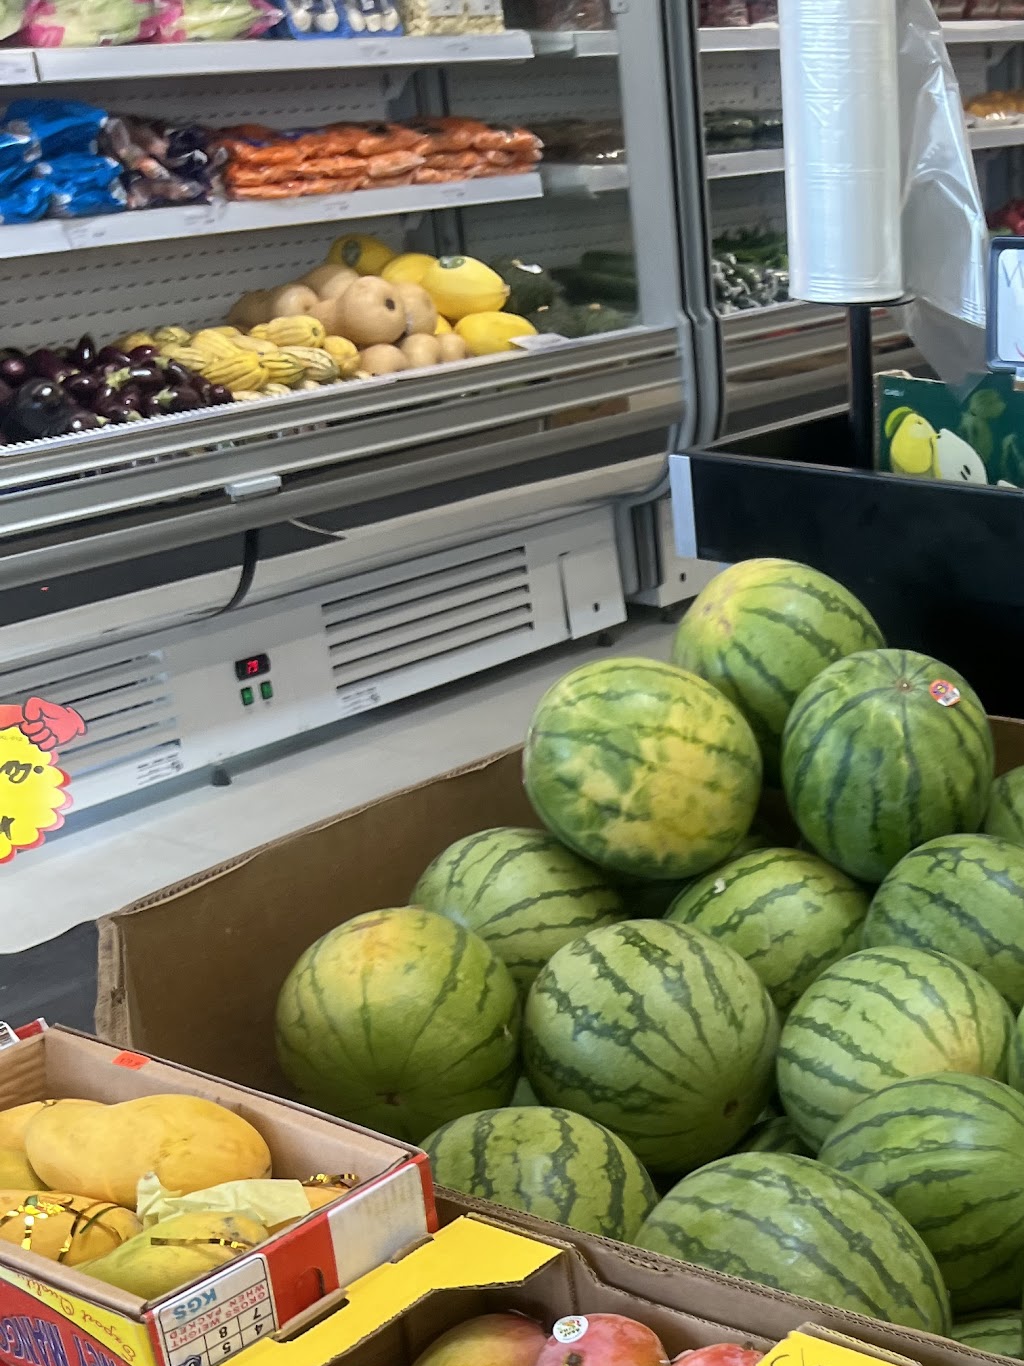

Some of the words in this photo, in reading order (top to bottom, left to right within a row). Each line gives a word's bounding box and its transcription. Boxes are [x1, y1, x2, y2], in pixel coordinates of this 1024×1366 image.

[172, 1287, 218, 1320] KGS
[225, 1291, 266, 1319] GROSS
[229, 1283, 265, 1307] WHEN
[169, 1307, 222, 1340] PACKED
[252, 1307, 261, 1320] 7
[171, 1317, 221, 1348] WEIGHT
[218, 1326, 228, 1338] 8
[254, 1324, 264, 1335] 4
[222, 1342, 232, 1354] 5
